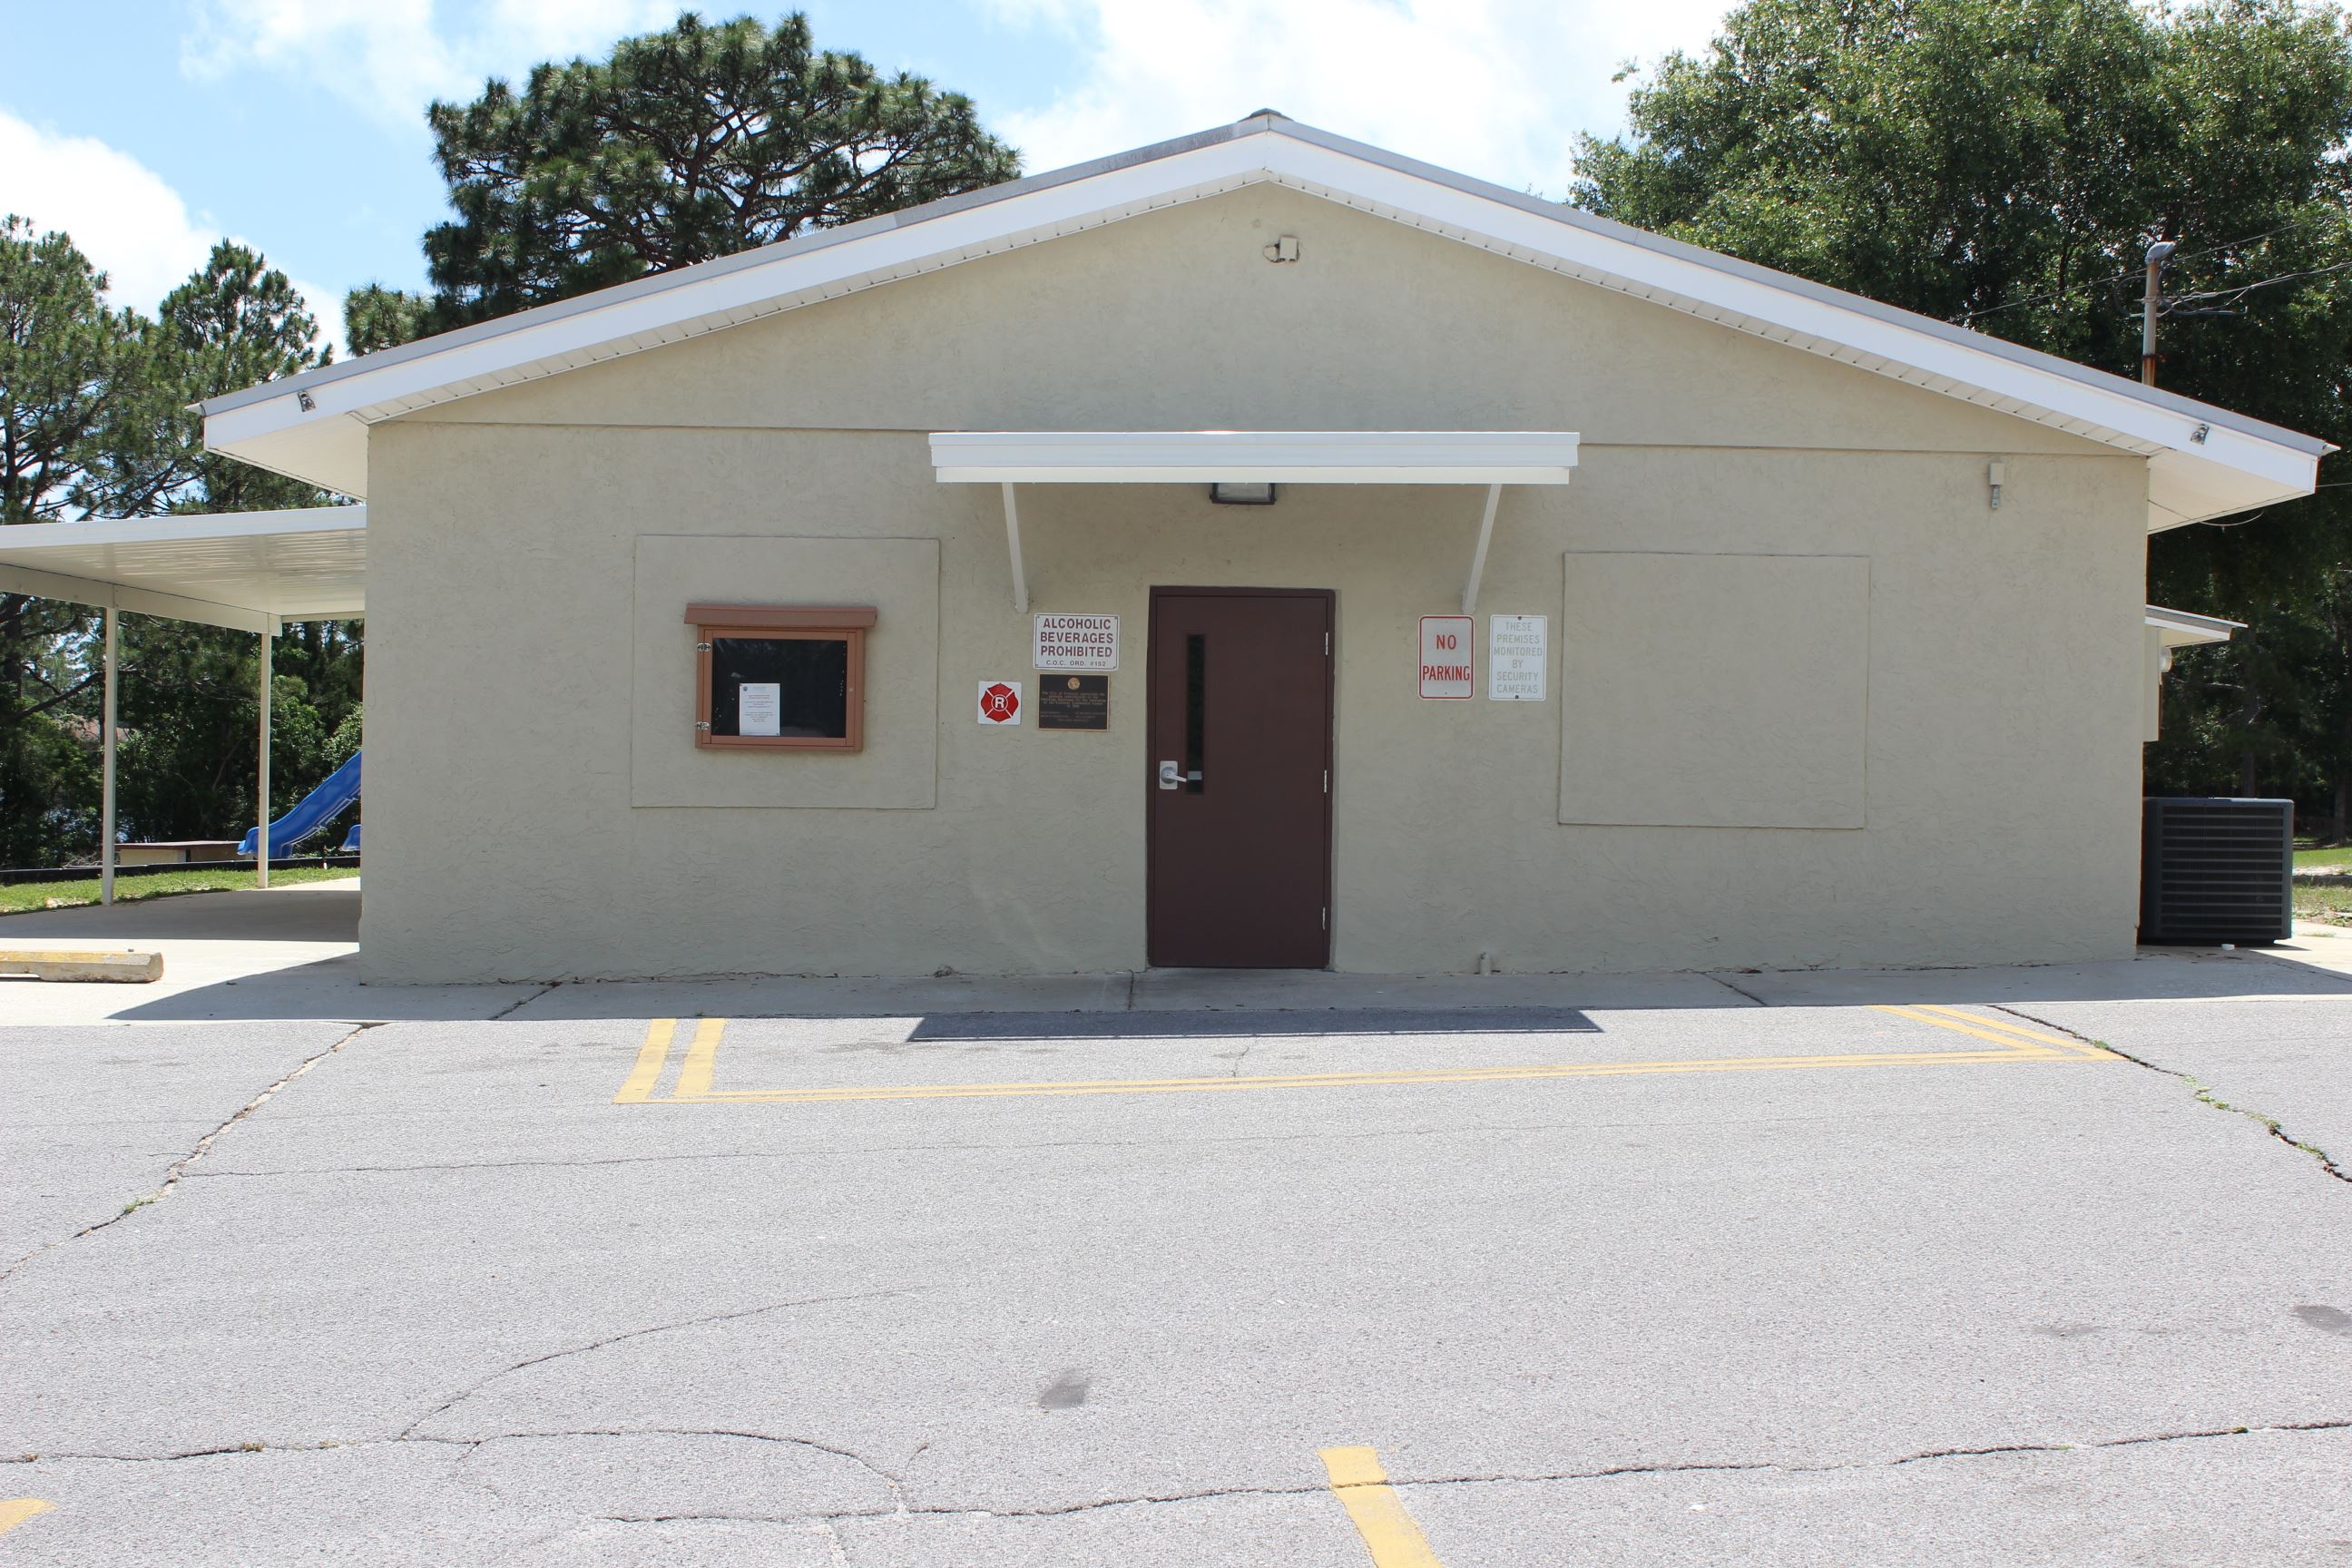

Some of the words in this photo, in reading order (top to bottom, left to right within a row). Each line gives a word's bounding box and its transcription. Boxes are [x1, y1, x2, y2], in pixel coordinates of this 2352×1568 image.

[1043, 618, 1112, 630] ALCOHOLIC
[1504, 622, 1533, 632] THESE
[1040, 632, 1113, 643] BEVERAGES
[1436, 634, 1456, 650] NO
[1496, 634, 1540, 644] PREMISES
[1040, 645, 1112, 657] PROHIBITED
[1494, 647, 1543, 657] MONITORED
[1512, 659, 1524, 669] BY
[1422, 665, 1471, 681] PARKING
[1496, 671, 1539, 681] SECURITY
[1496, 684, 1538, 694] CAMERAS
[995, 697, 1004, 709] R
